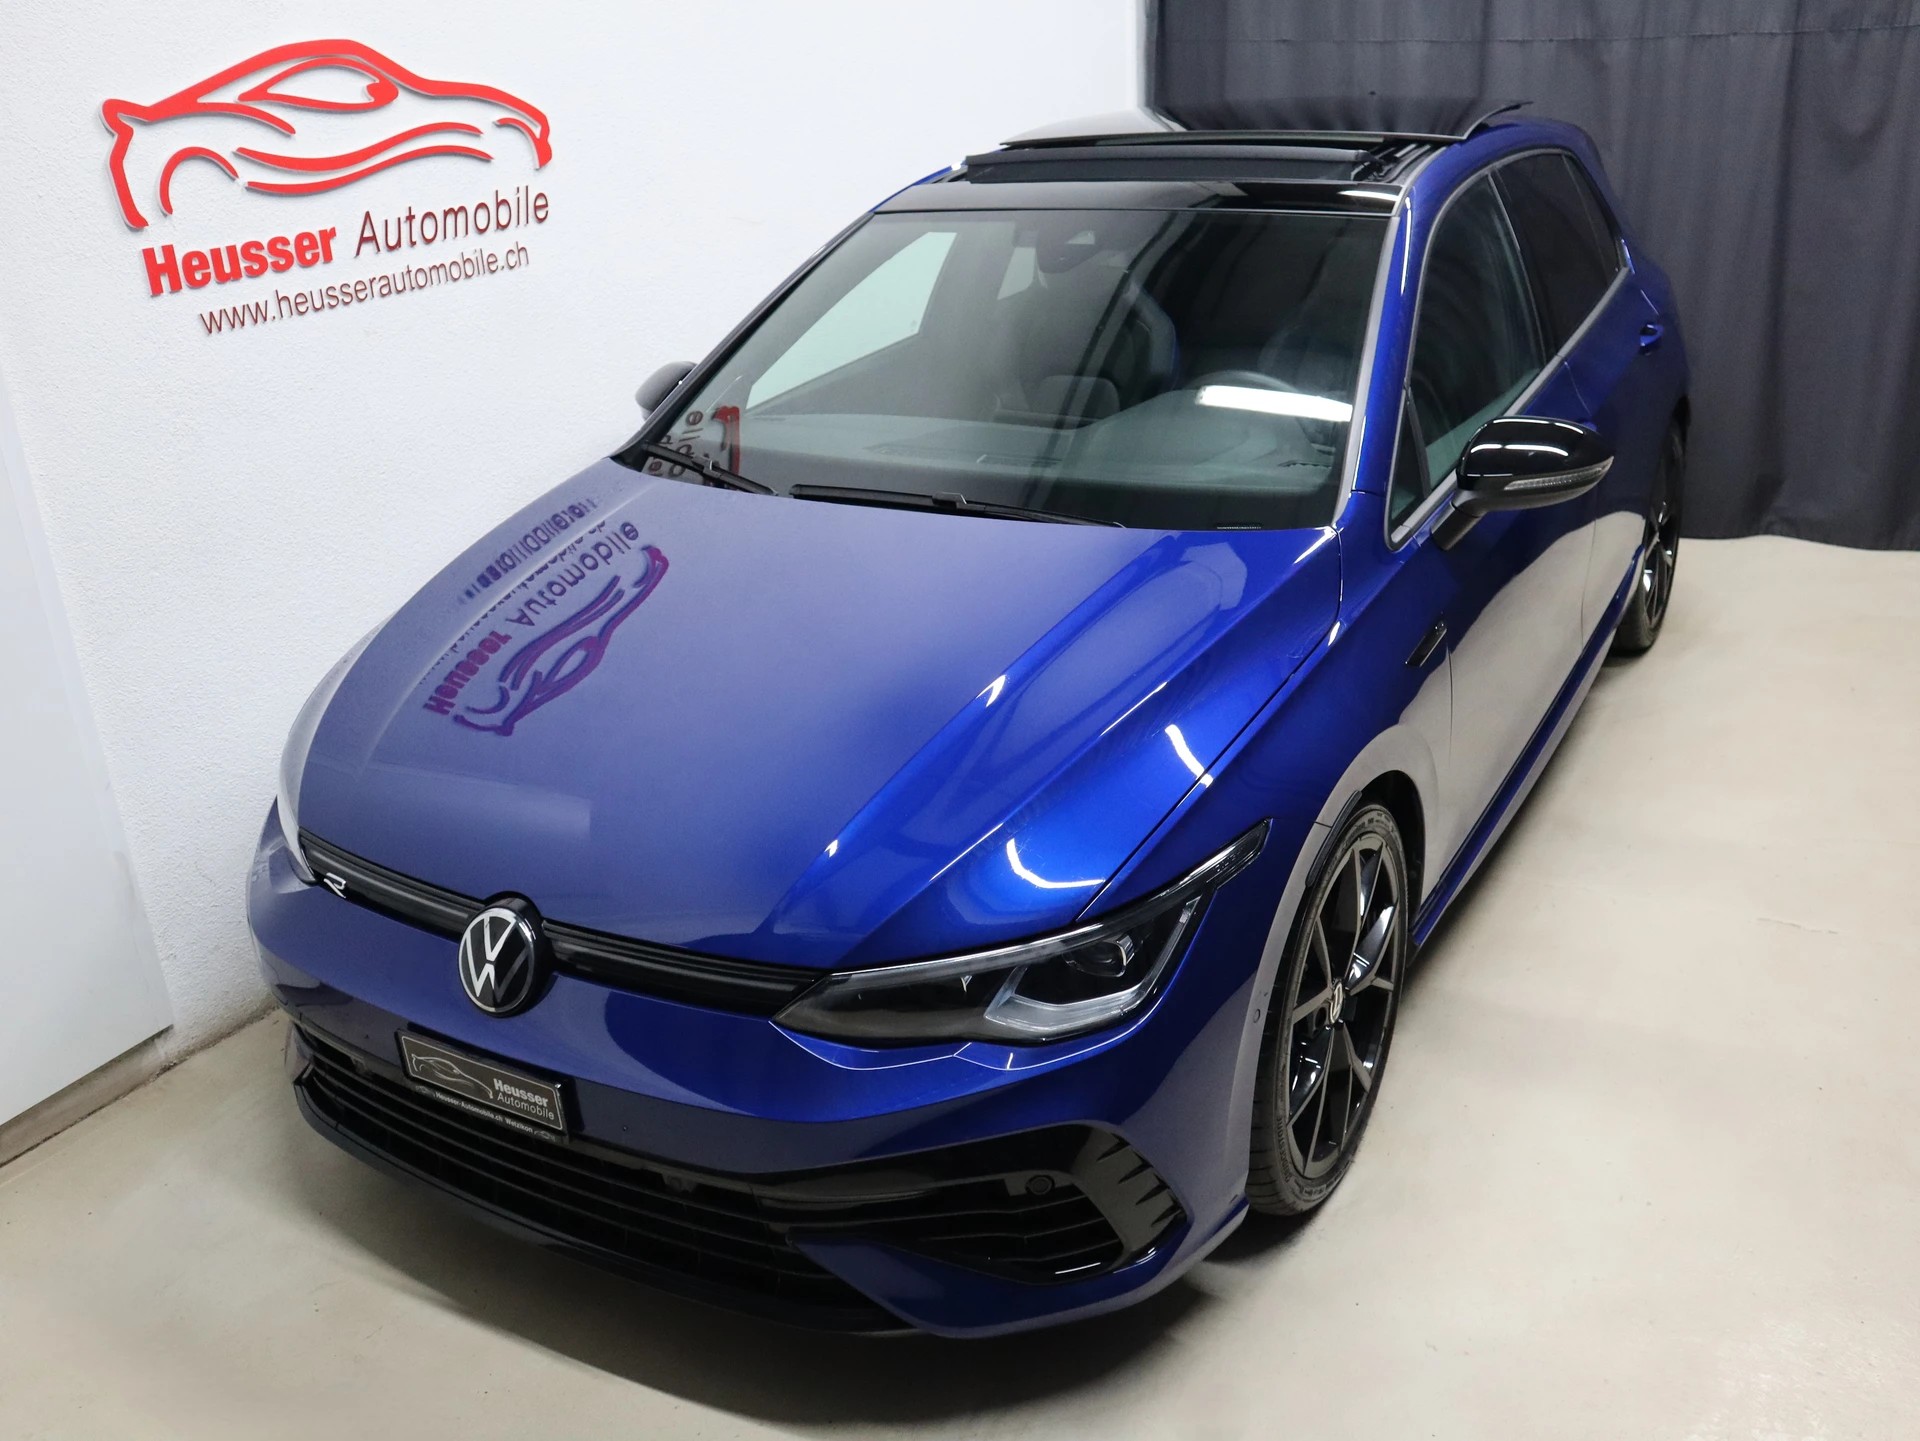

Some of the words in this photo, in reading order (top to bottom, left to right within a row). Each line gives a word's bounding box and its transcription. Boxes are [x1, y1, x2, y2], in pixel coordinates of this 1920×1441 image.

[141, 226, 337, 297] Heusser
[354, 184, 549, 257] Automobile
[200, 241, 530, 335] www.heusserautomobile.ch
[493, 1078, 549, 1107] Heusser
[497, 1093, 555, 1121] Automobile
